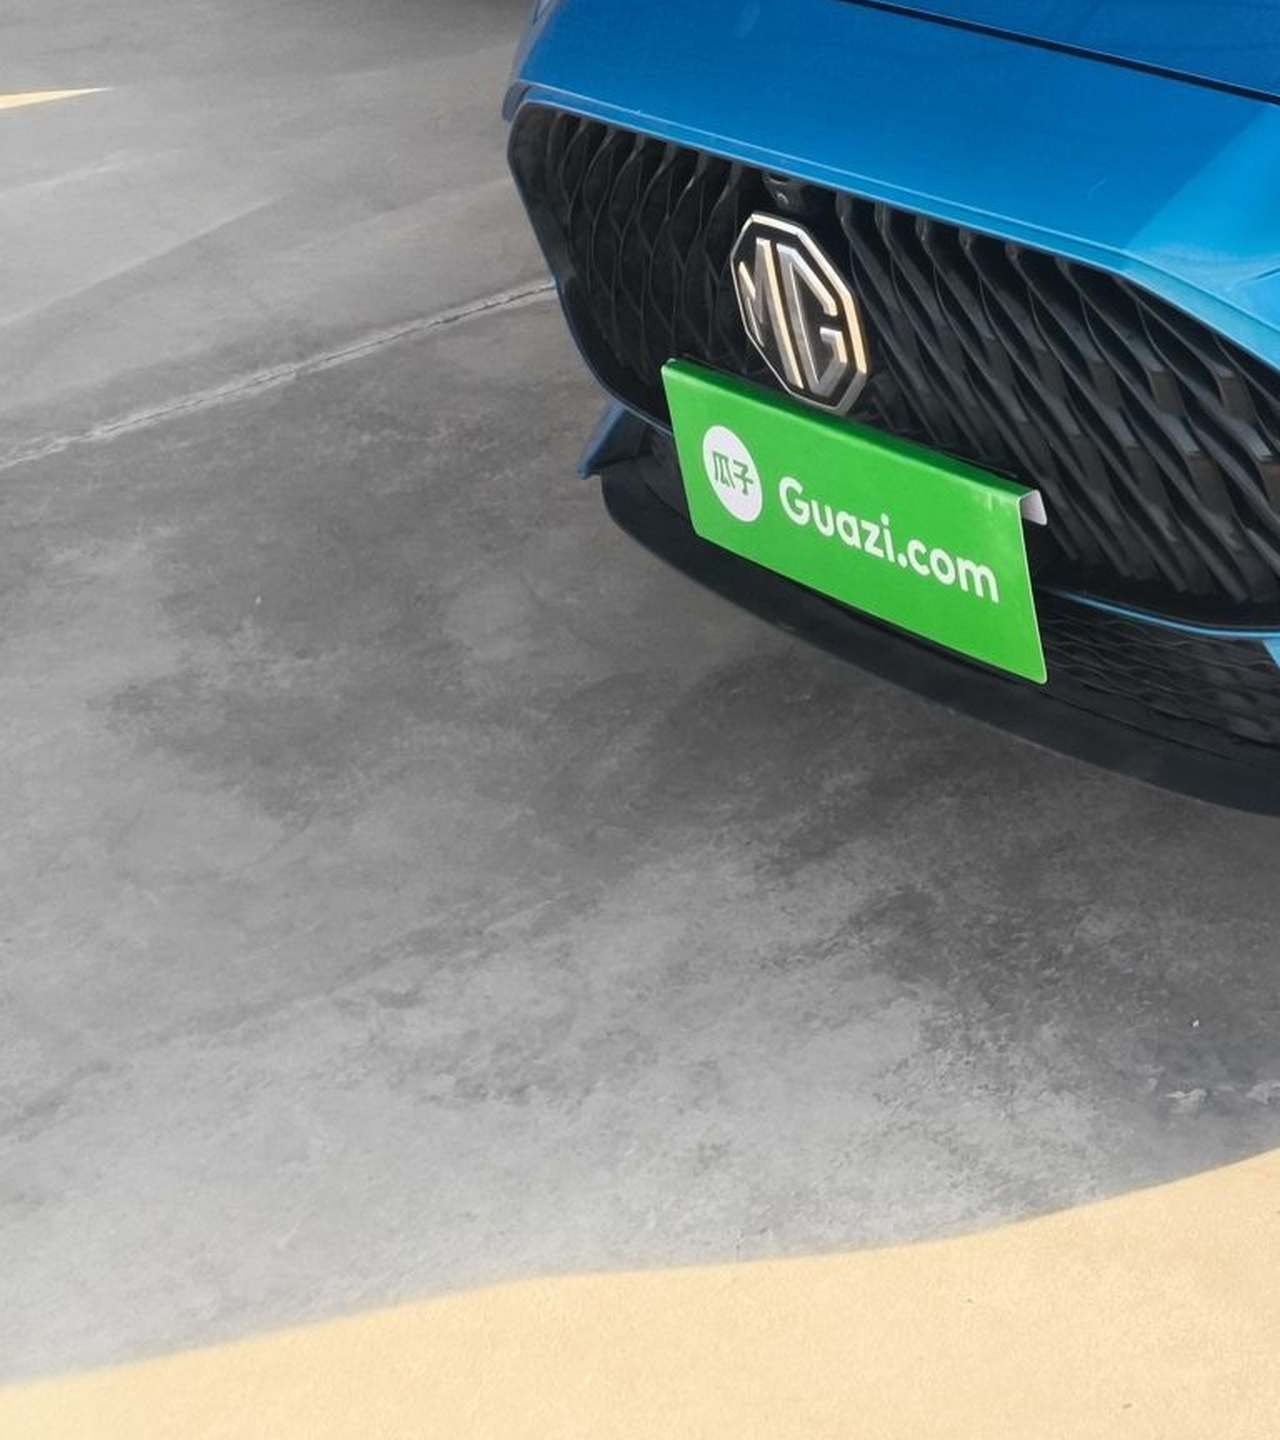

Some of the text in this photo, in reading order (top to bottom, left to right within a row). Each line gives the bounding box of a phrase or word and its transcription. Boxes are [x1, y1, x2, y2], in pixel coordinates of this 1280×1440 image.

[736, 232, 850, 400] MG
[712, 451, 755, 496] 瓜子
[779, 477, 999, 603] Guazi.com
